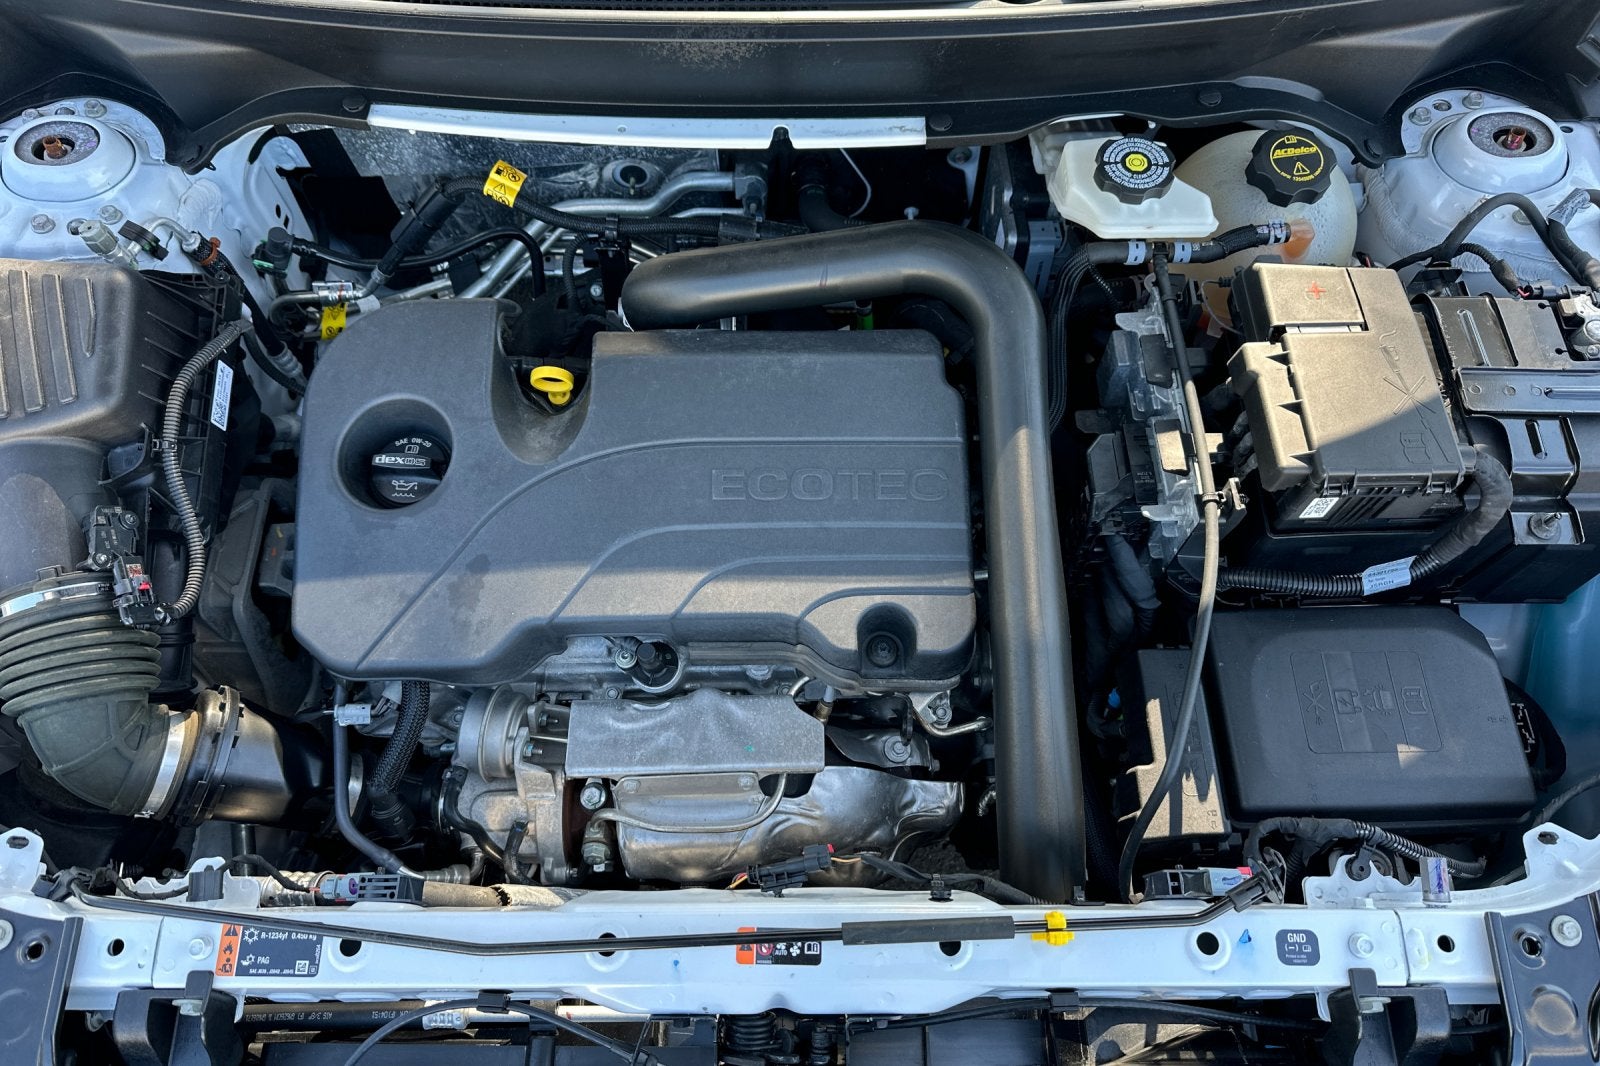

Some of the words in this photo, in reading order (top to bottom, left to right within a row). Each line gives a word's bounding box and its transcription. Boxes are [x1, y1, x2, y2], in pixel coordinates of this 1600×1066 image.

[1274, 146, 1317, 156] ACDelco
[395, 438, 408, 446] SAE
[375, 455, 426, 466] dexos
[712, 468, 948, 500] ECOTEC
[260, 932, 288, 940] R-1234yf
[1288, 933, 1306, 943] GND
[257, 956, 270, 964] PAG
